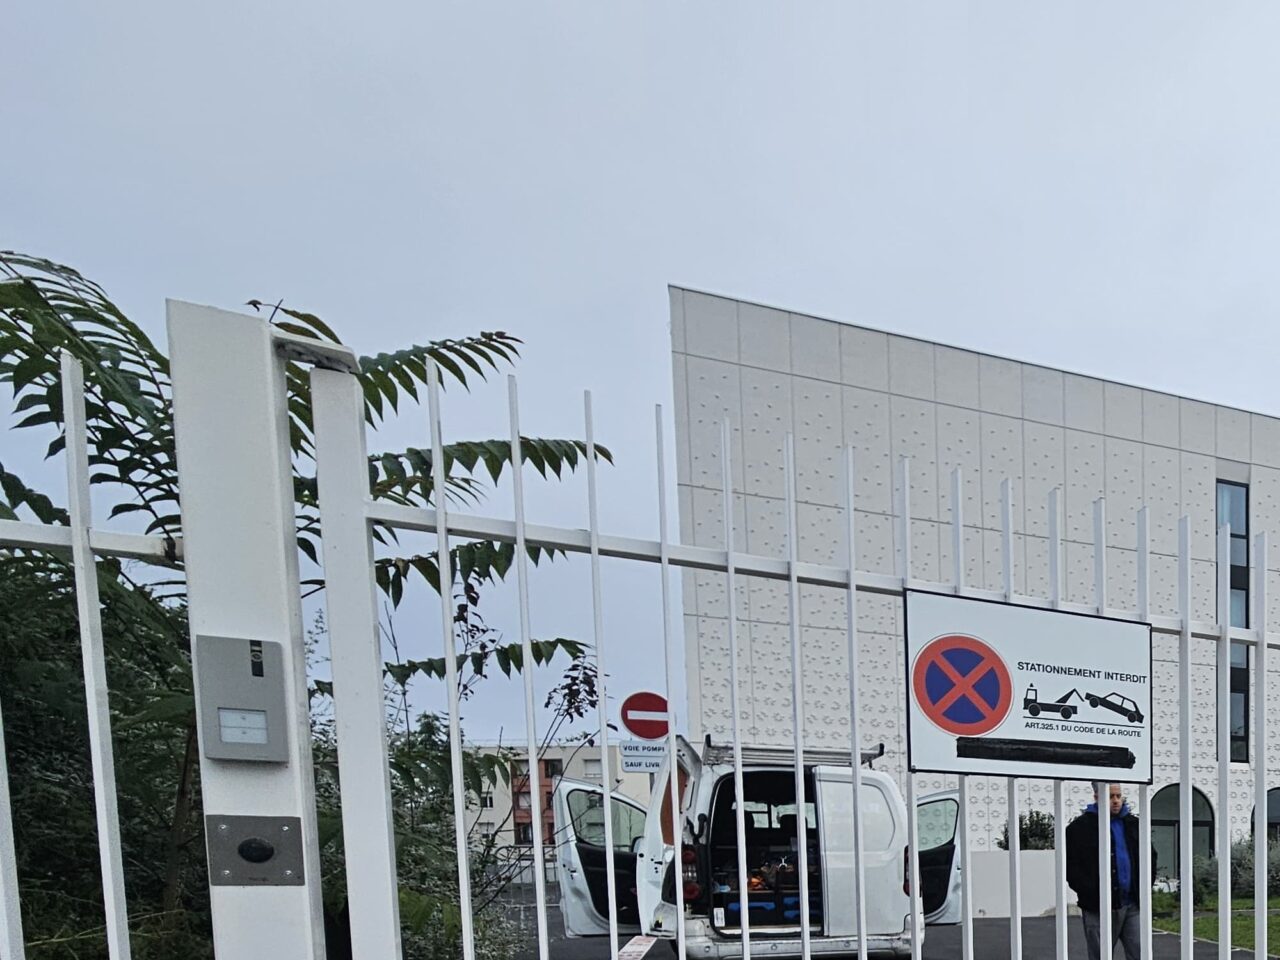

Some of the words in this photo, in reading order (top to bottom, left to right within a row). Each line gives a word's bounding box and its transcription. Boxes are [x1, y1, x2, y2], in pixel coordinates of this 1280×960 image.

[1017, 661, 1102, 679] STATIONNEMENT
[1104, 671, 1147, 684] INTERDIT
[1061, 723, 1072, 732] DU
[1073, 725, 1095, 734] CODE
[1095, 727, 1106, 735] DE
[1107, 728, 1117, 736] LA
[1117, 729, 1142, 738] ROUTE
